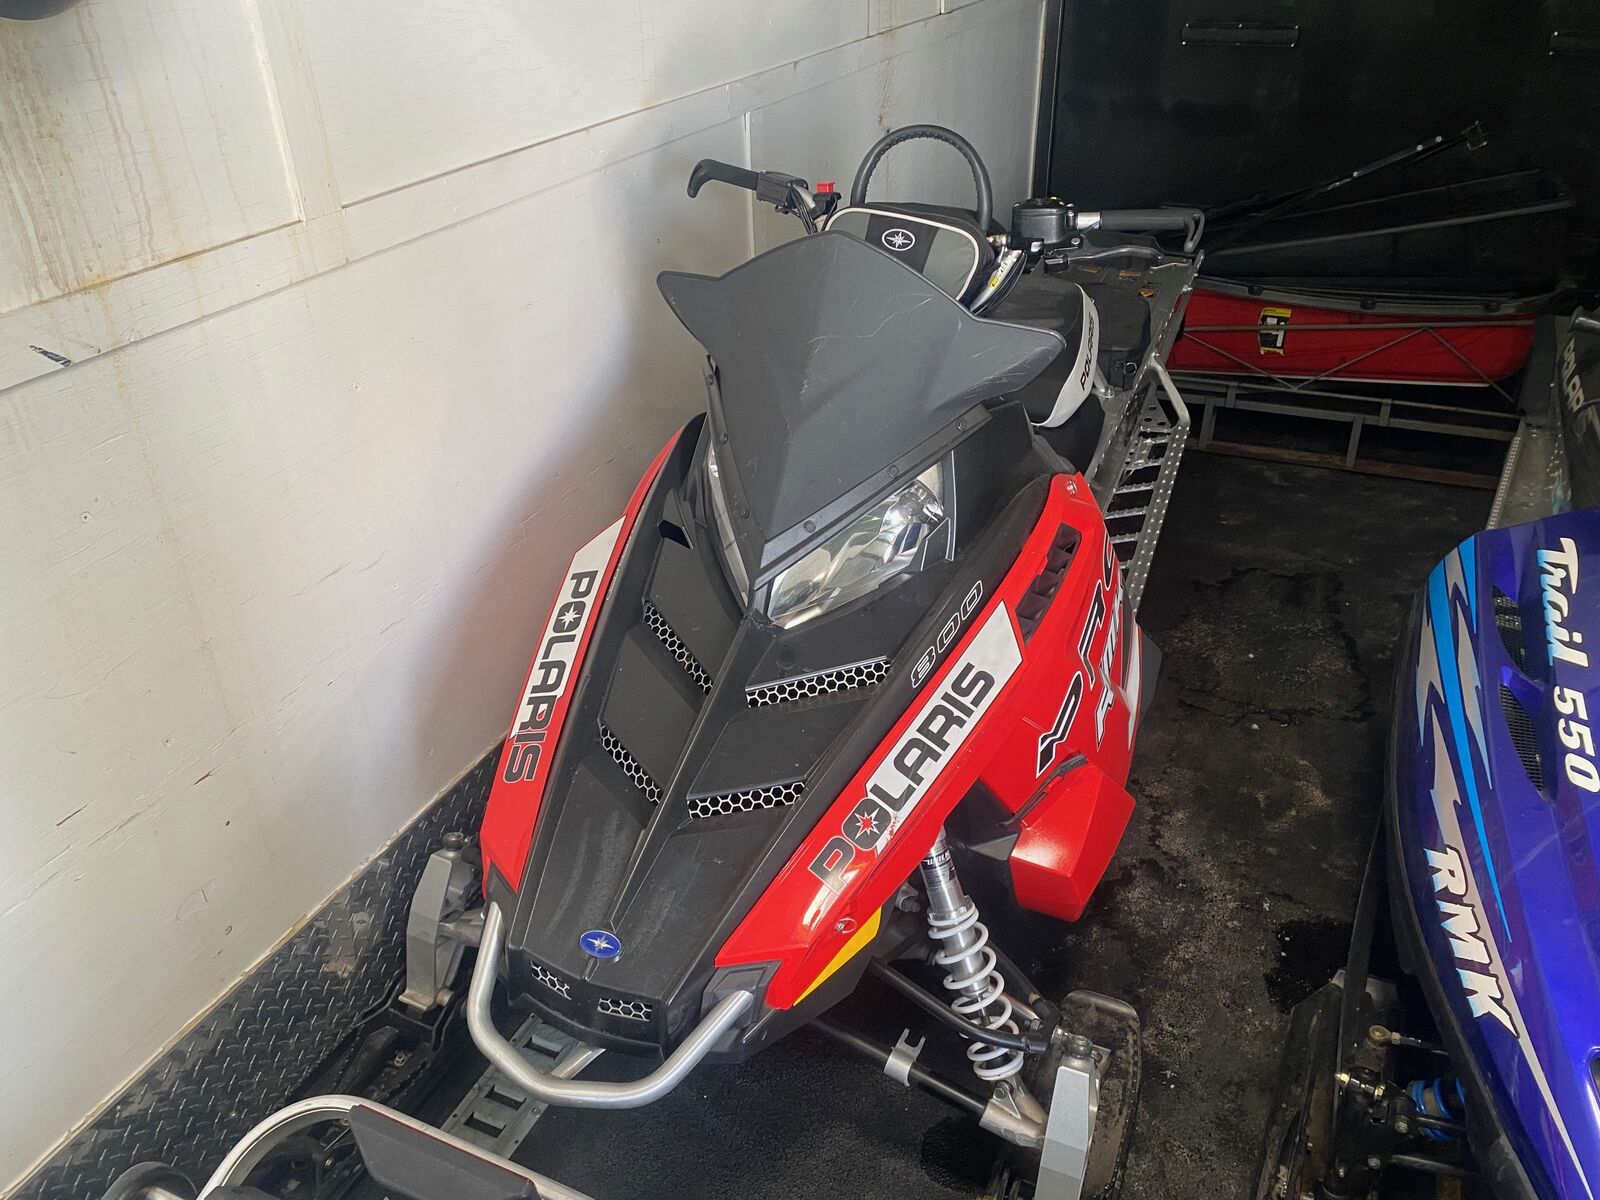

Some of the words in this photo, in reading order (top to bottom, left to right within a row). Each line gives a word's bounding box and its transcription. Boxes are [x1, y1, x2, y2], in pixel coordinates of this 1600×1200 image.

[1080, 312, 1095, 391] POLARIS
[911, 579, 984, 689] 800
[1537, 537, 1589, 669] Trail
[504, 569, 599, 783] POLARIS
[1554, 684, 1600, 794] 550
[808, 662, 995, 887] POLARIS
[1424, 846, 1519, 1037] RMK
